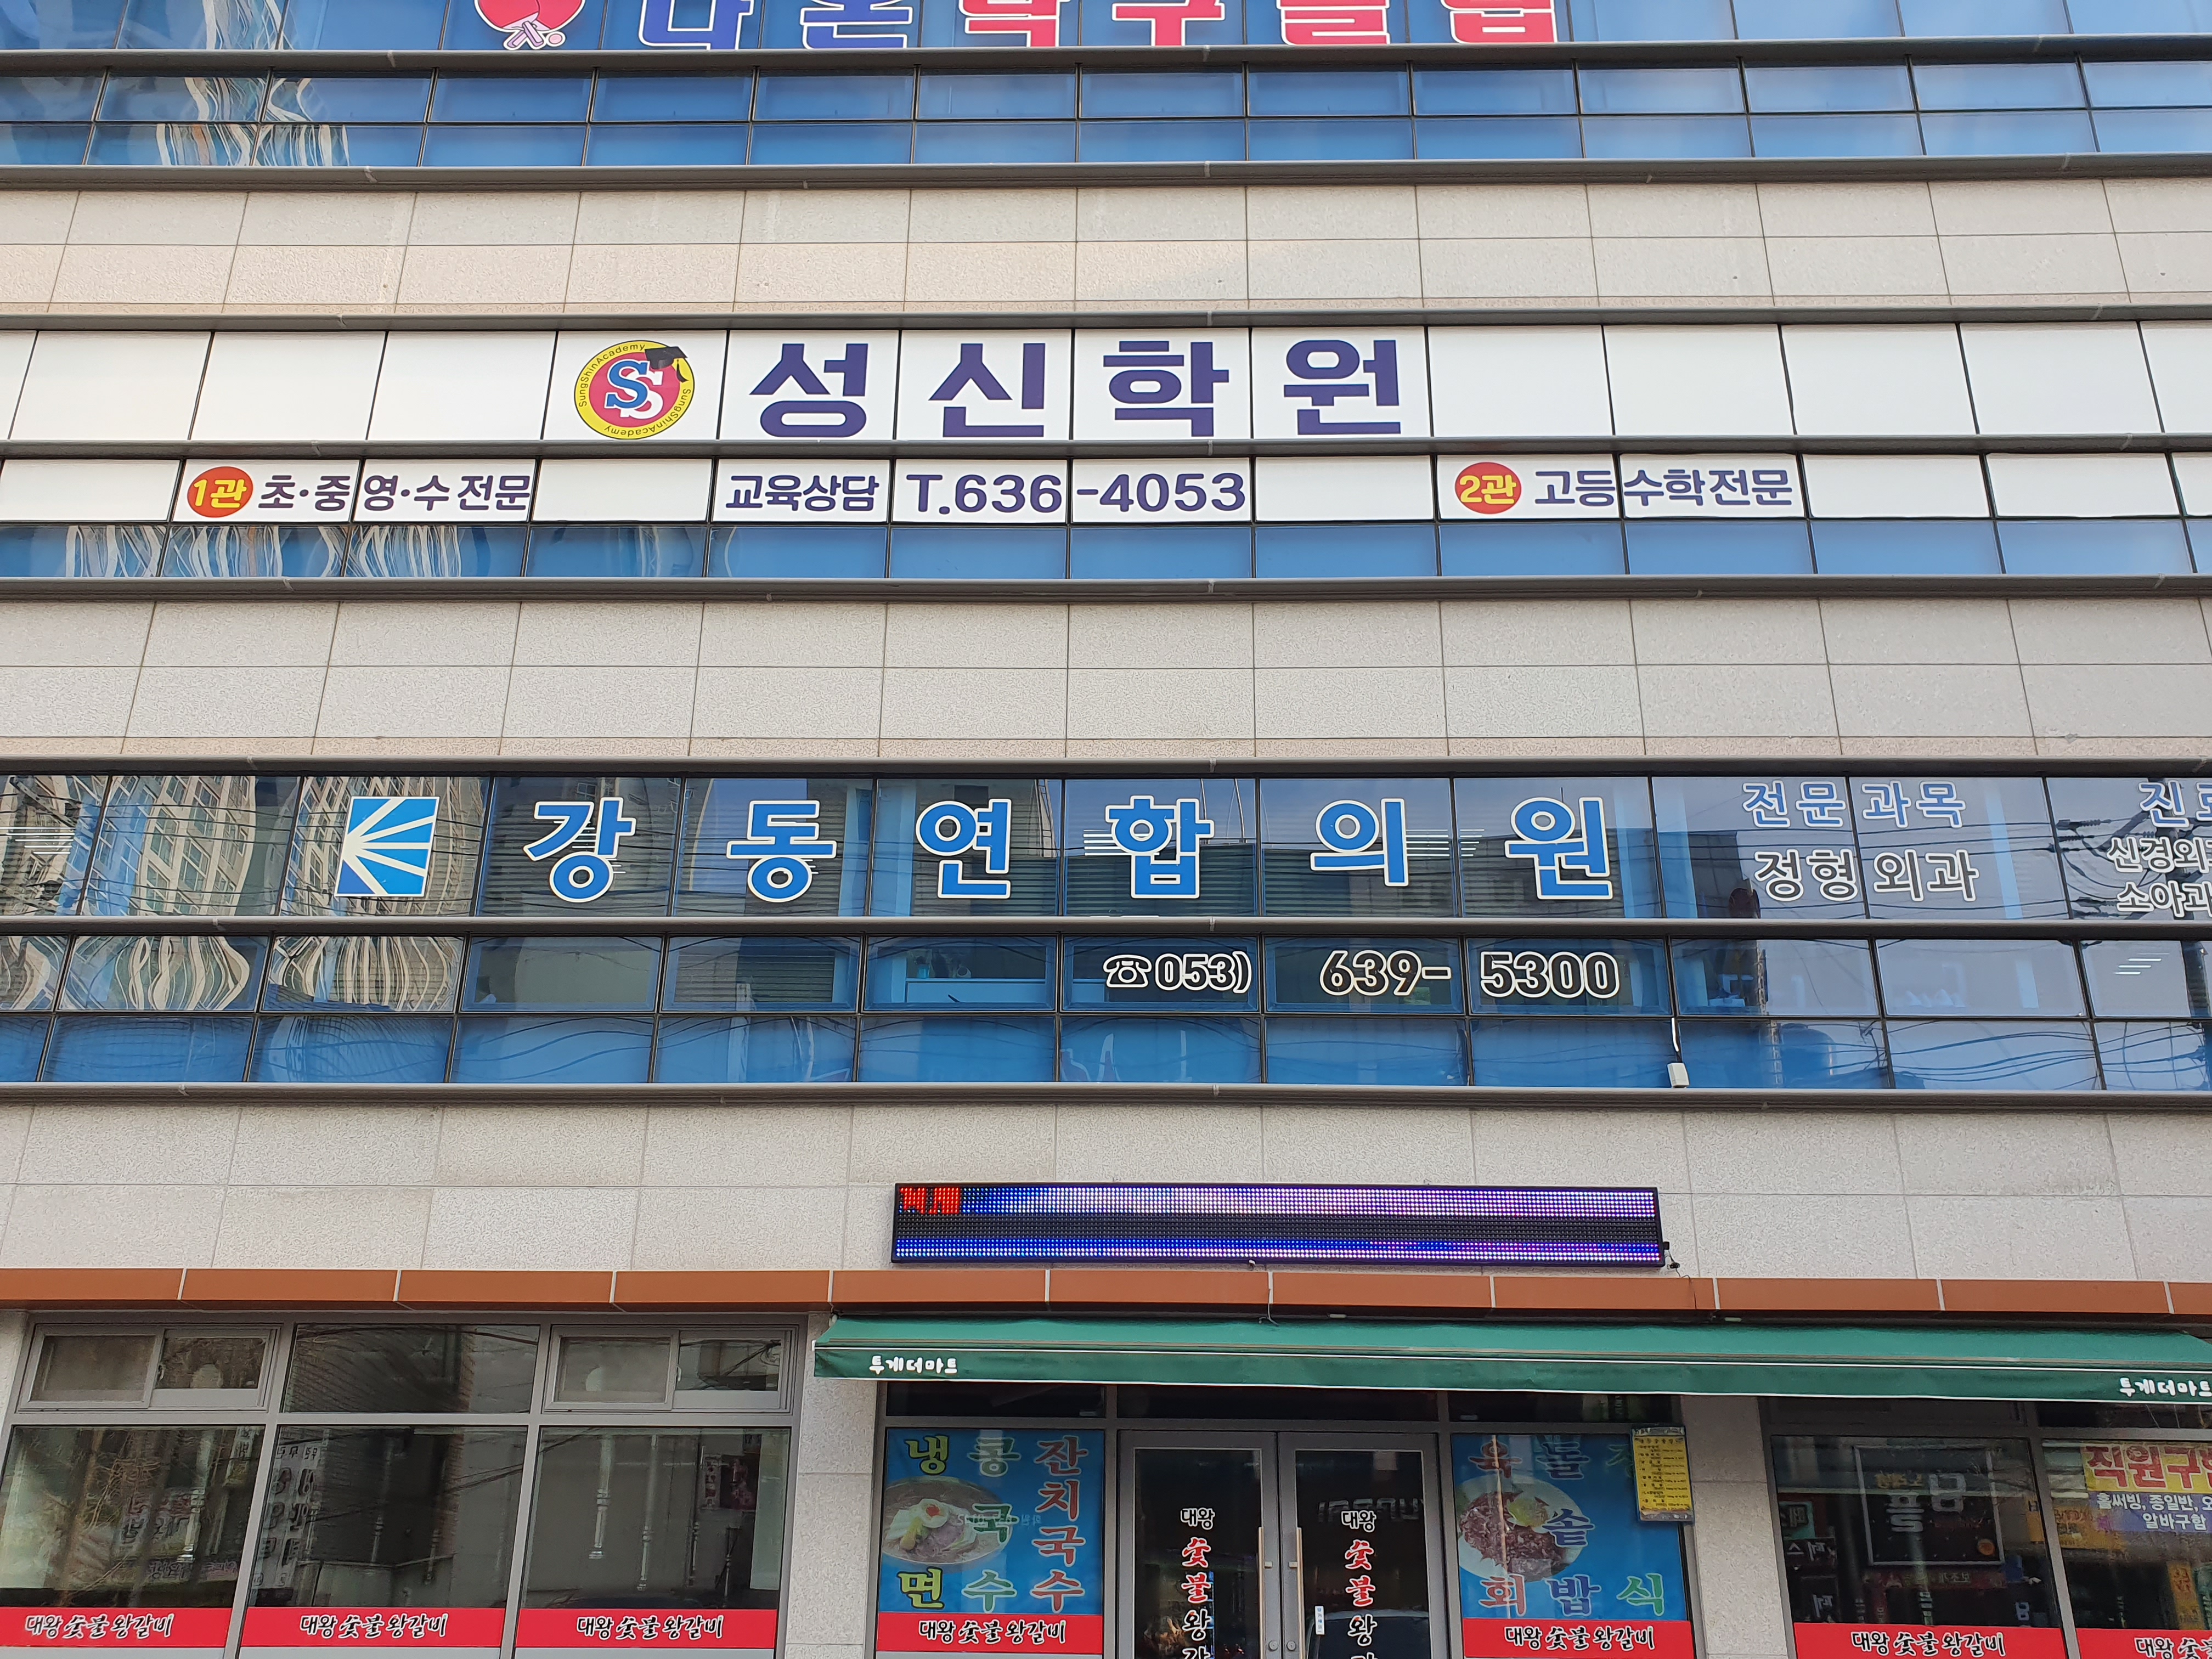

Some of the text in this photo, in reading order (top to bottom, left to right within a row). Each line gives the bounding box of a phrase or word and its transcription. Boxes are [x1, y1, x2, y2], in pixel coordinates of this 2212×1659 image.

[749, 340, 1401, 438] 성신학원
[193, 478, 247, 508] 1관
[725, 475, 880, 511] 교육상담
[1458, 473, 1517, 505] 2관
[2107, 836, 2212, 873] 신경외
[1480, 950, 1620, 999] 5300
[870, 1355, 957, 1374] 투게더마트
[2119, 1377, 2212, 1397] 투게더마트
[897, 1435, 949, 1610] 냉면
[1030, 1435, 1089, 1613] 잔치국수
[1180, 1507, 1215, 1530] 대왕
[1341, 1510, 1376, 1532] 대왕
[2142, 1513, 2207, 1531] 알바구함
[25, 1612, 175, 1640] 대왕 숯불 왕갈비
[299, 1613, 448, 1639] 대왕 숯불 왕갈비
[577, 1615, 724, 1641] 대왕 숯불 왕갈비
[918, 1619, 1066, 1645] 대왕 숯불 왕갈비
[1504, 1625, 1656, 1651] 대왕 숯불 왕갈비
[1850, 1630, 2007, 1657] 대왕 숯불 왕갈비
